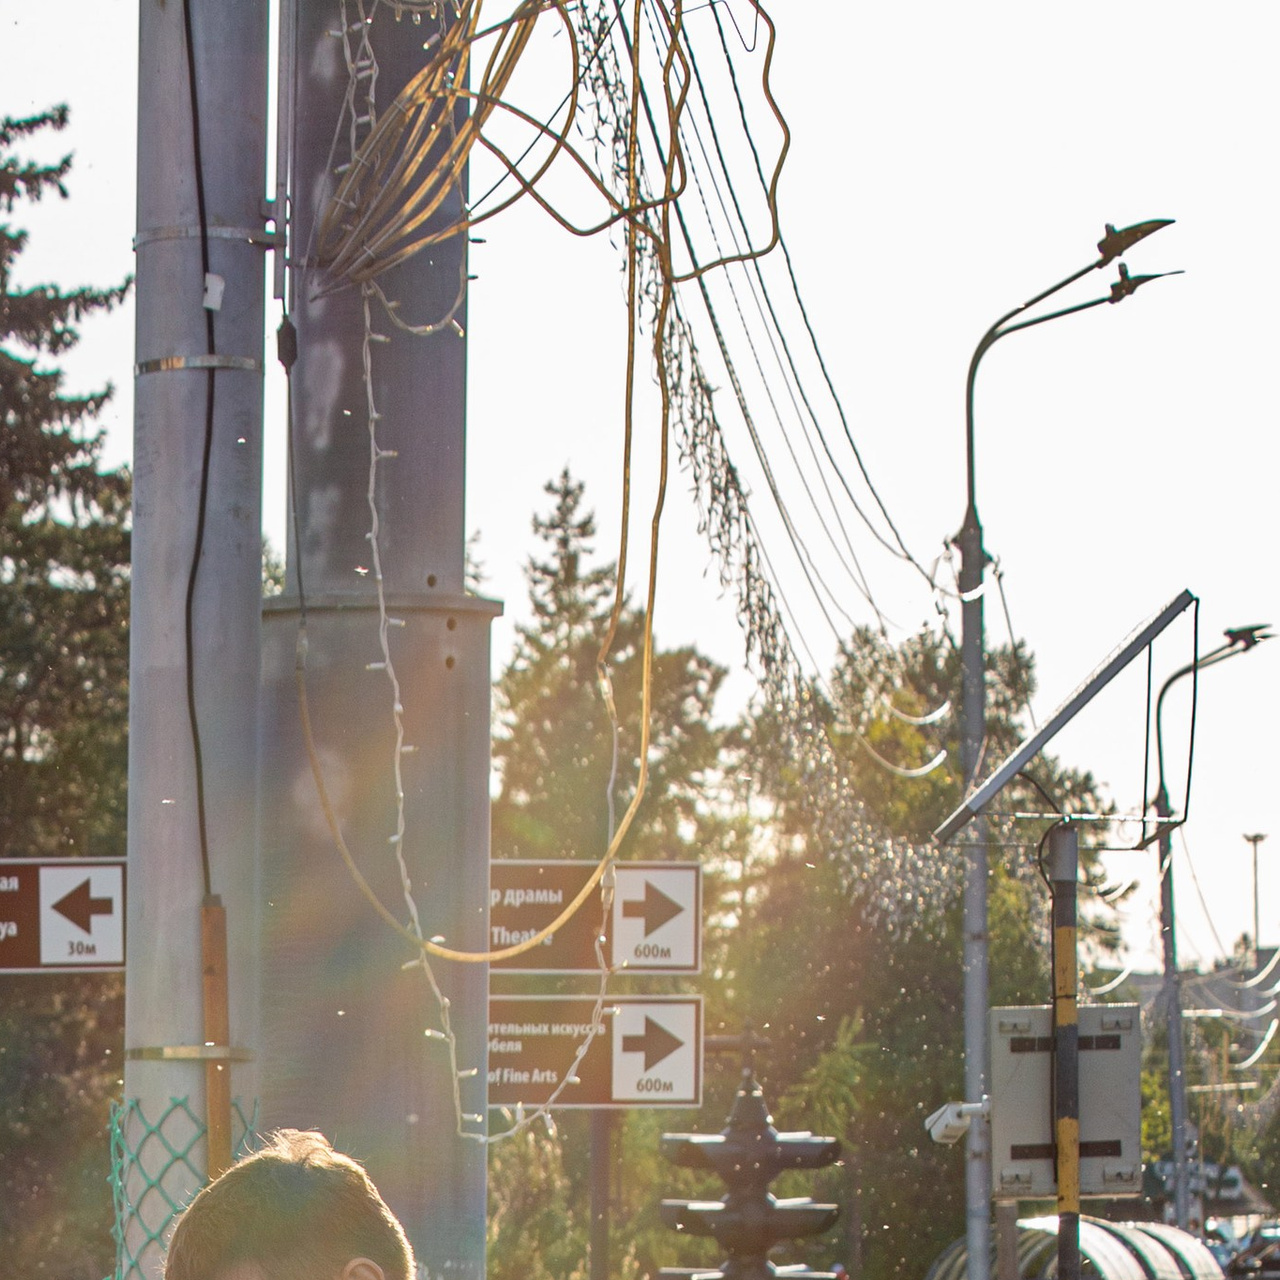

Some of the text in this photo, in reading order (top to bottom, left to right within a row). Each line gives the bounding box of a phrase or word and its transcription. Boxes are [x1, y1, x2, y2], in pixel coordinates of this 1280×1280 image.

[503, 888, 563, 908] драмы
[491, 926, 553, 946] Theate
[67, 940, 97, 956] 30м
[634, 943, 671, 958] 600м
[551, 1023, 606, 1038] искуссв
[503, 1067, 530, 1083] Fine
[531, 1067, 558, 1083] Arts
[636, 1077, 674, 1092] 600м
